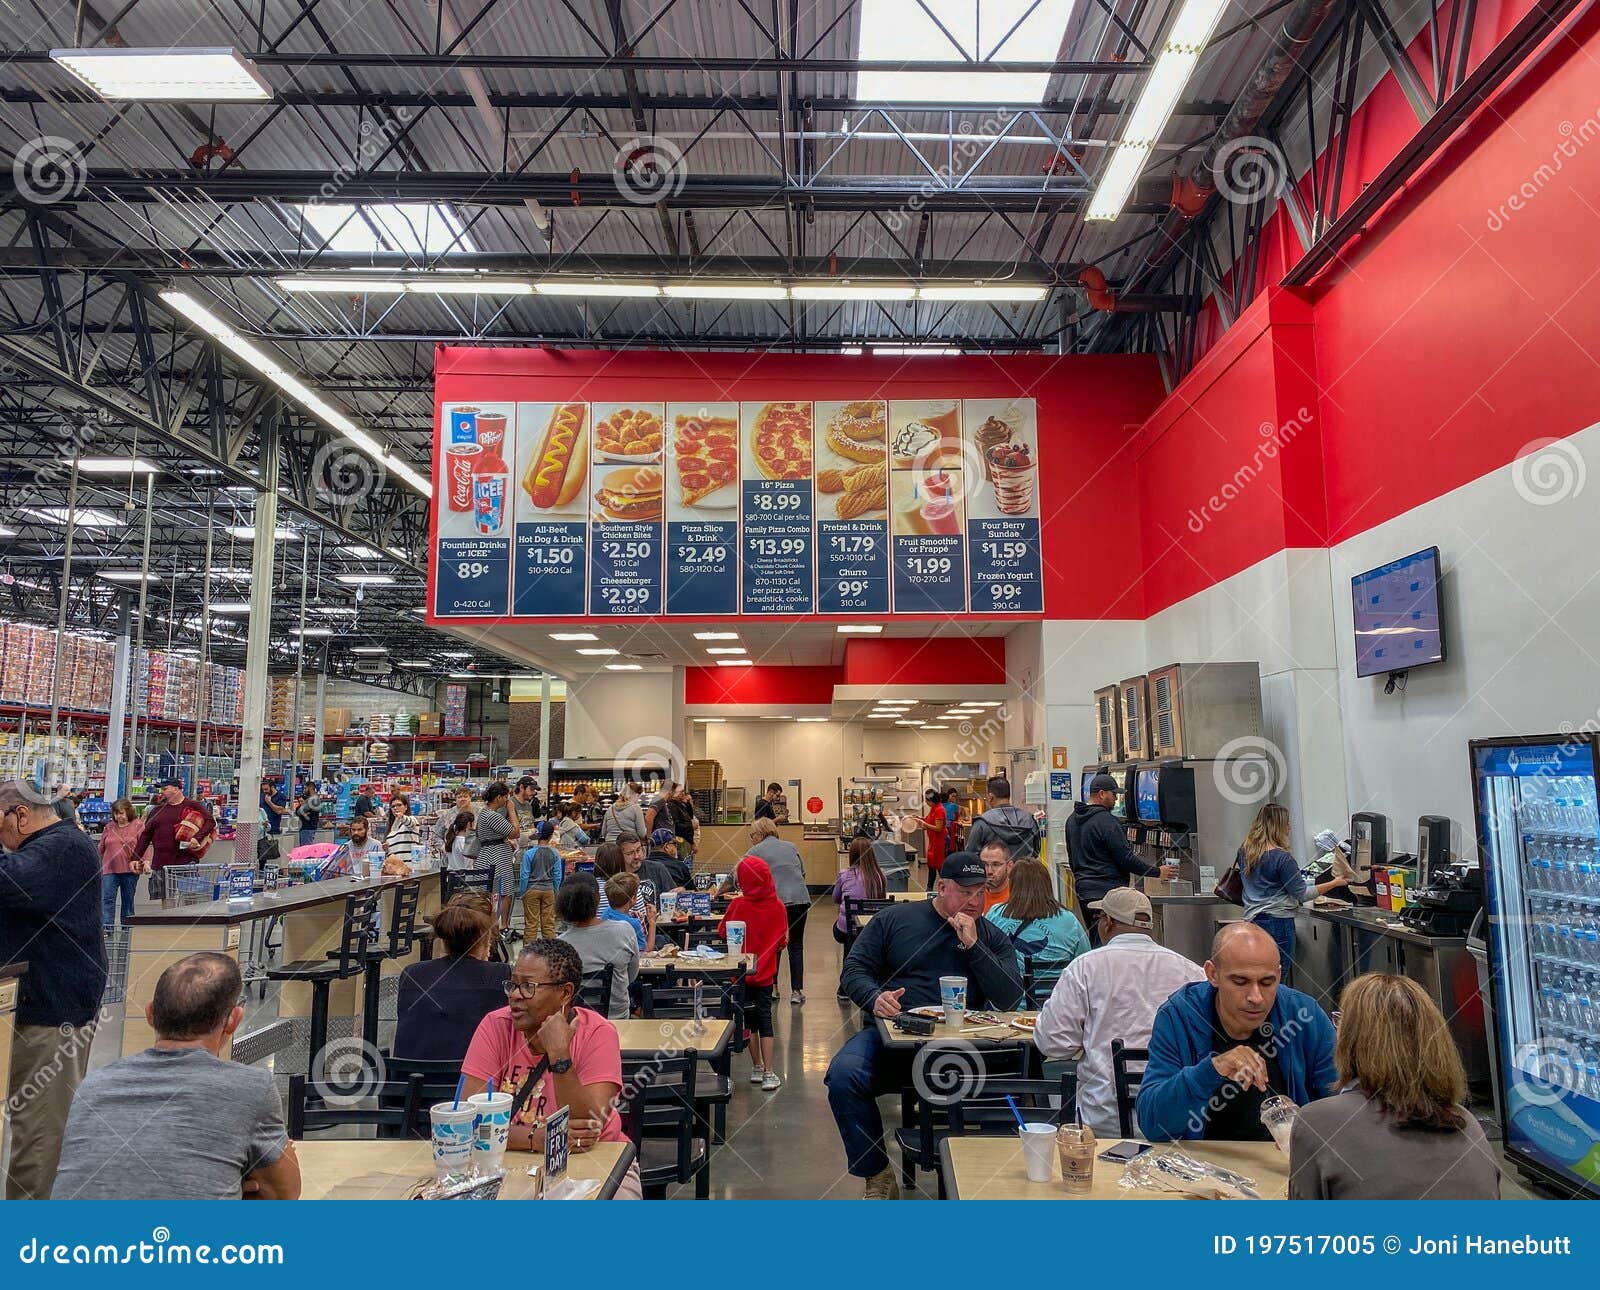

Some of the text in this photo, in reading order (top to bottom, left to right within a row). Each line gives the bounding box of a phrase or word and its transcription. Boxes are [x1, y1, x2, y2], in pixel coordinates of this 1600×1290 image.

[478, 481, 504, 498] ICEE
[753, 494, 801, 510] $8.99
[745, 526, 767, 534] Family
[787, 525, 810, 533] Combo
[860, 523, 882, 531] Drink
[982, 521, 1025, 530] Four Berry
[442, 541, 507, 549] Fountain Drinks
[535, 536, 551, 544] Dog
[561, 535, 584, 543] Drink
[695, 534, 718, 542] Drink
[831, 536, 875, 552] $1.79
[899, 537, 958, 546] Fruit Smoothie
[602, 542, 651, 558] $2.50
[678, 546, 727, 563] $2.49
[750, 538, 805, 555] $13.99
[982, 542, 1027, 558] $1.59
[527, 547, 574, 564] $1.50
[830, 554, 863, 562] 550-1010
[457, 562, 489, 579] 89¢
[528, 566, 572, 574] 510-960 Cal
[680, 565, 726, 573] 580-1120 Cal
[907, 557, 951, 574] $1.99
[909, 575, 938, 583] 170-270
[977, 572, 1034, 580] Frozen Yogurt
[602, 587, 650, 604] $2.99
[838, 580, 869, 597] 99¢
[990, 584, 1022, 601] 99¢
[478, 600, 491, 608] Cal
[612, 605, 640, 613] 650 Cal
[550, 1134, 566, 1155] FRI
[549, 1150, 566, 1172] DAY
